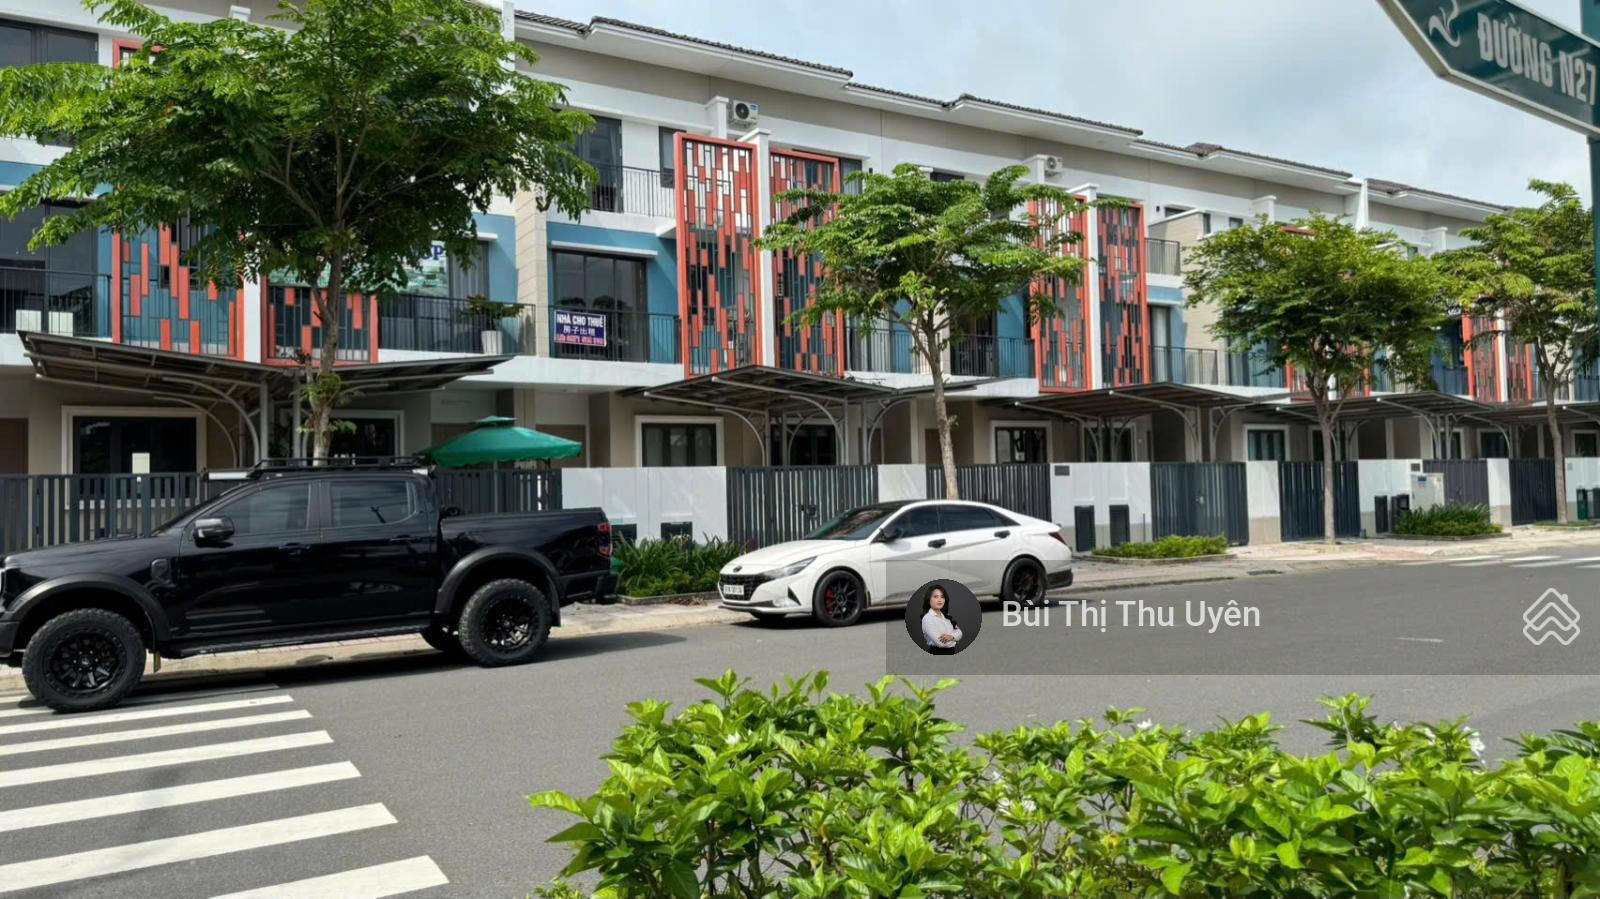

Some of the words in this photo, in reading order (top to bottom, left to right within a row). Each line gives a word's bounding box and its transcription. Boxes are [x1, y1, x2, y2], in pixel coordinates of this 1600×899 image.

[1477, 11, 1554, 88] ĐƯỜNG
[1558, 50, 1597, 106] N27
[556, 312, 571, 325] NHÀ
[572, 315, 586, 326] CHO
